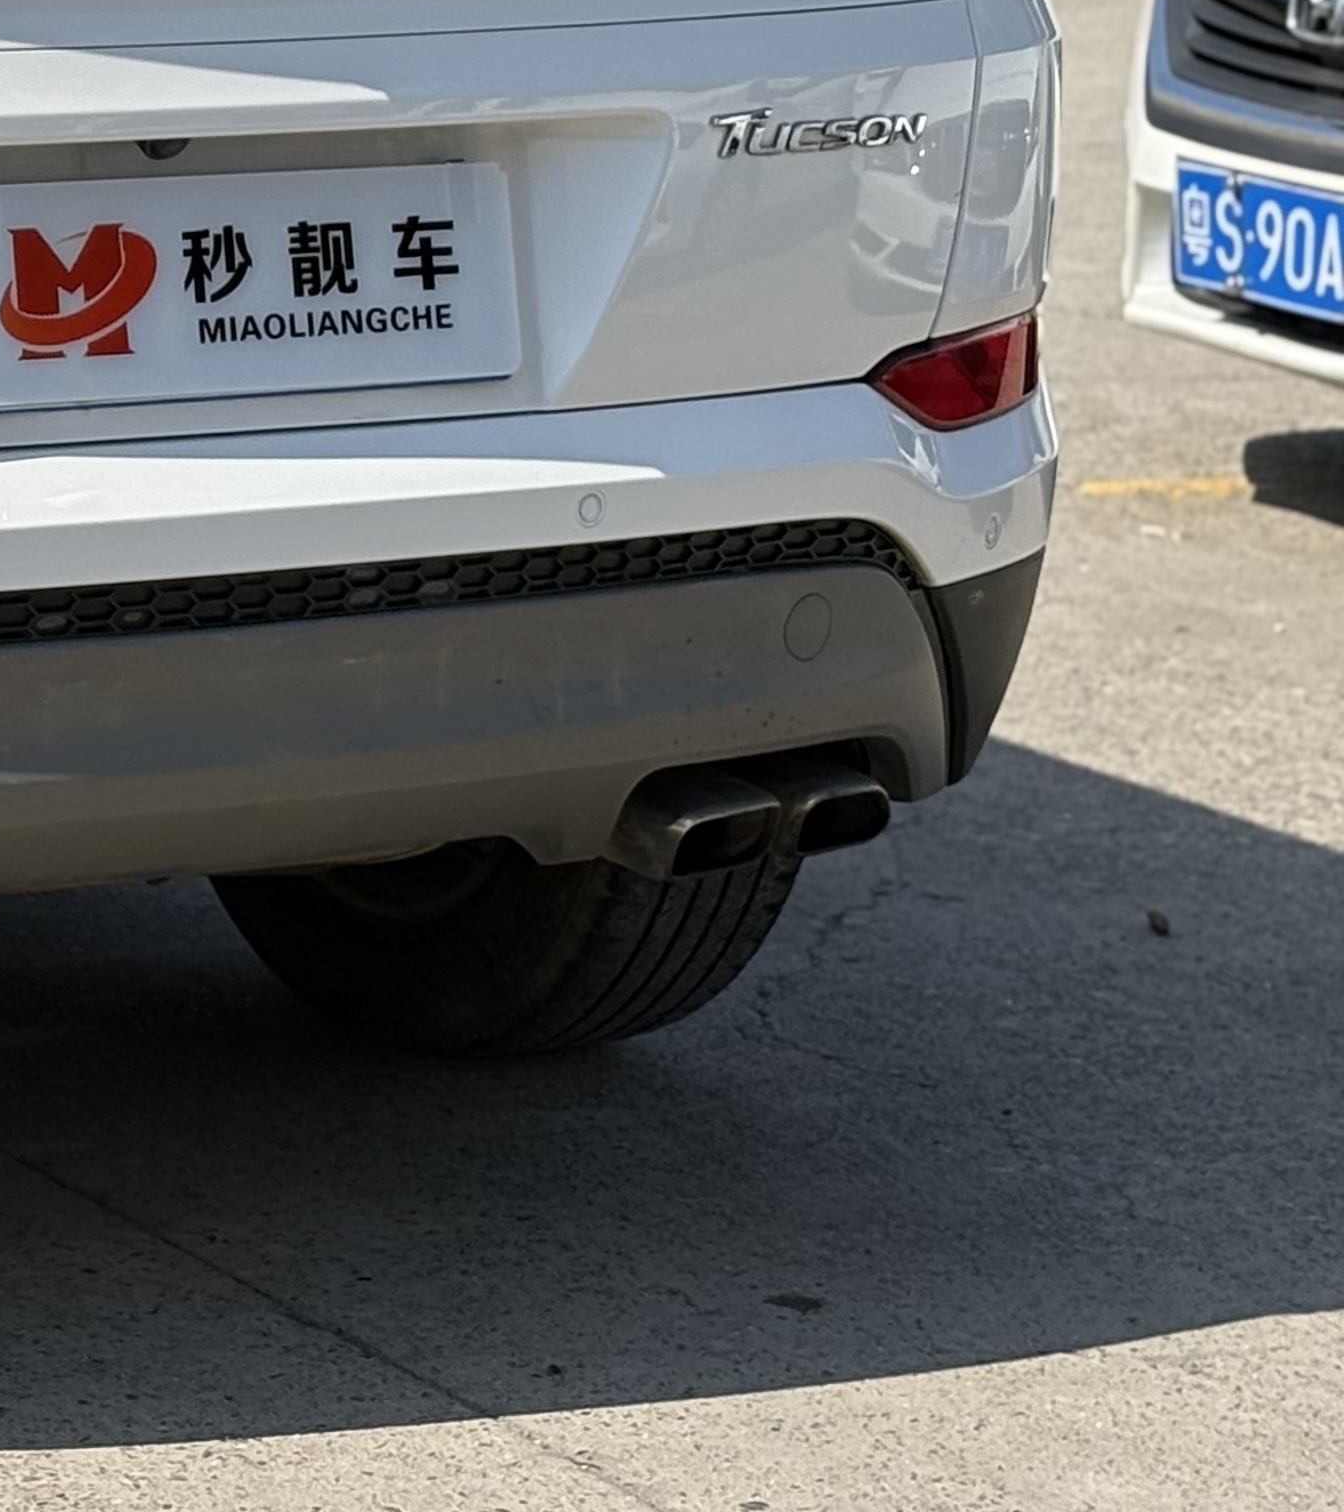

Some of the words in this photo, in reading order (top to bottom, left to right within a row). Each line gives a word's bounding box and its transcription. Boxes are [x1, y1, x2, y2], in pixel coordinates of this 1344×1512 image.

[181, 214, 461, 305] 秒靓车
[198, 302, 455, 345] MIAOLIANGCHE
